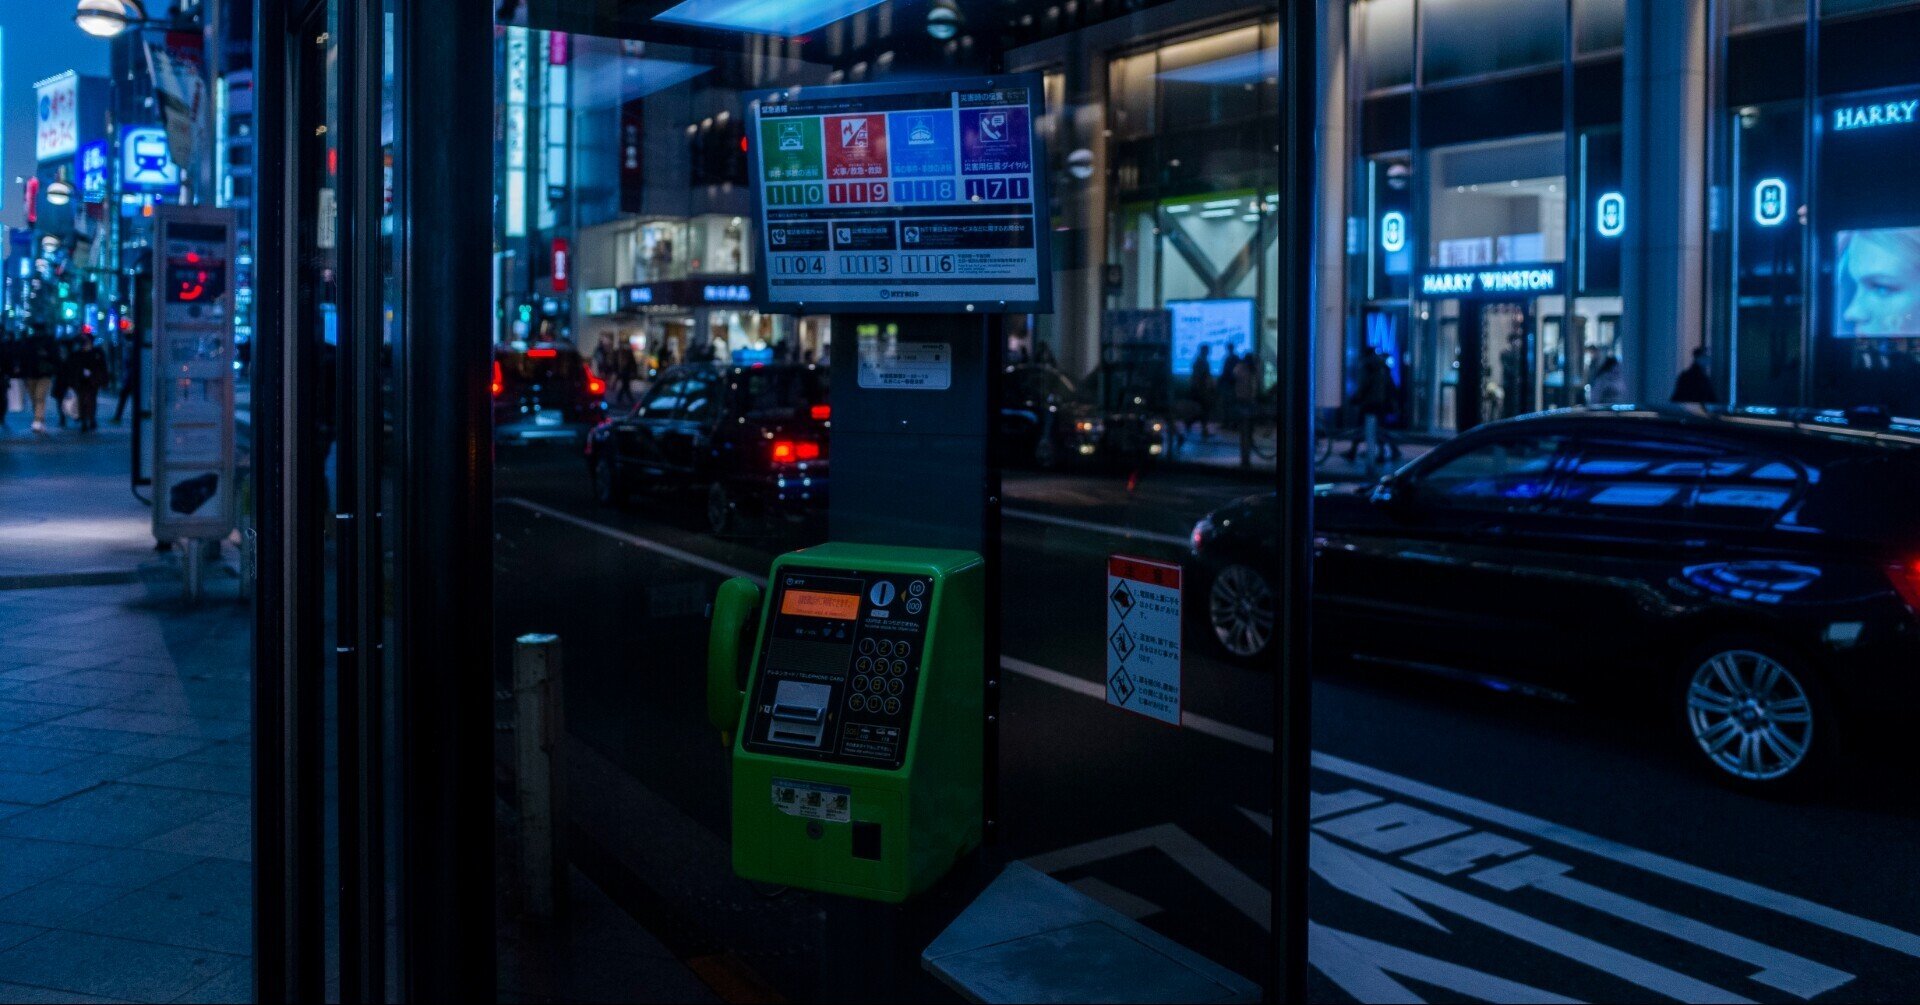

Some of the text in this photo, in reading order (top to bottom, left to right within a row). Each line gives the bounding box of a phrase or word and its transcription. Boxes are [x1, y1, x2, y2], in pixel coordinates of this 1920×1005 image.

[1834, 102, 1917, 133] HARRY
[773, 184, 820, 204] 110
[836, 182, 885, 202] 119
[901, 181, 952, 200] 118
[972, 180, 1022, 200] 171
[781, 256, 823, 273] 104
[846, 256, 889, 273] 113
[907, 255, 952, 272] 116
[1423, 269, 1556, 294] HARRY WINSTON
